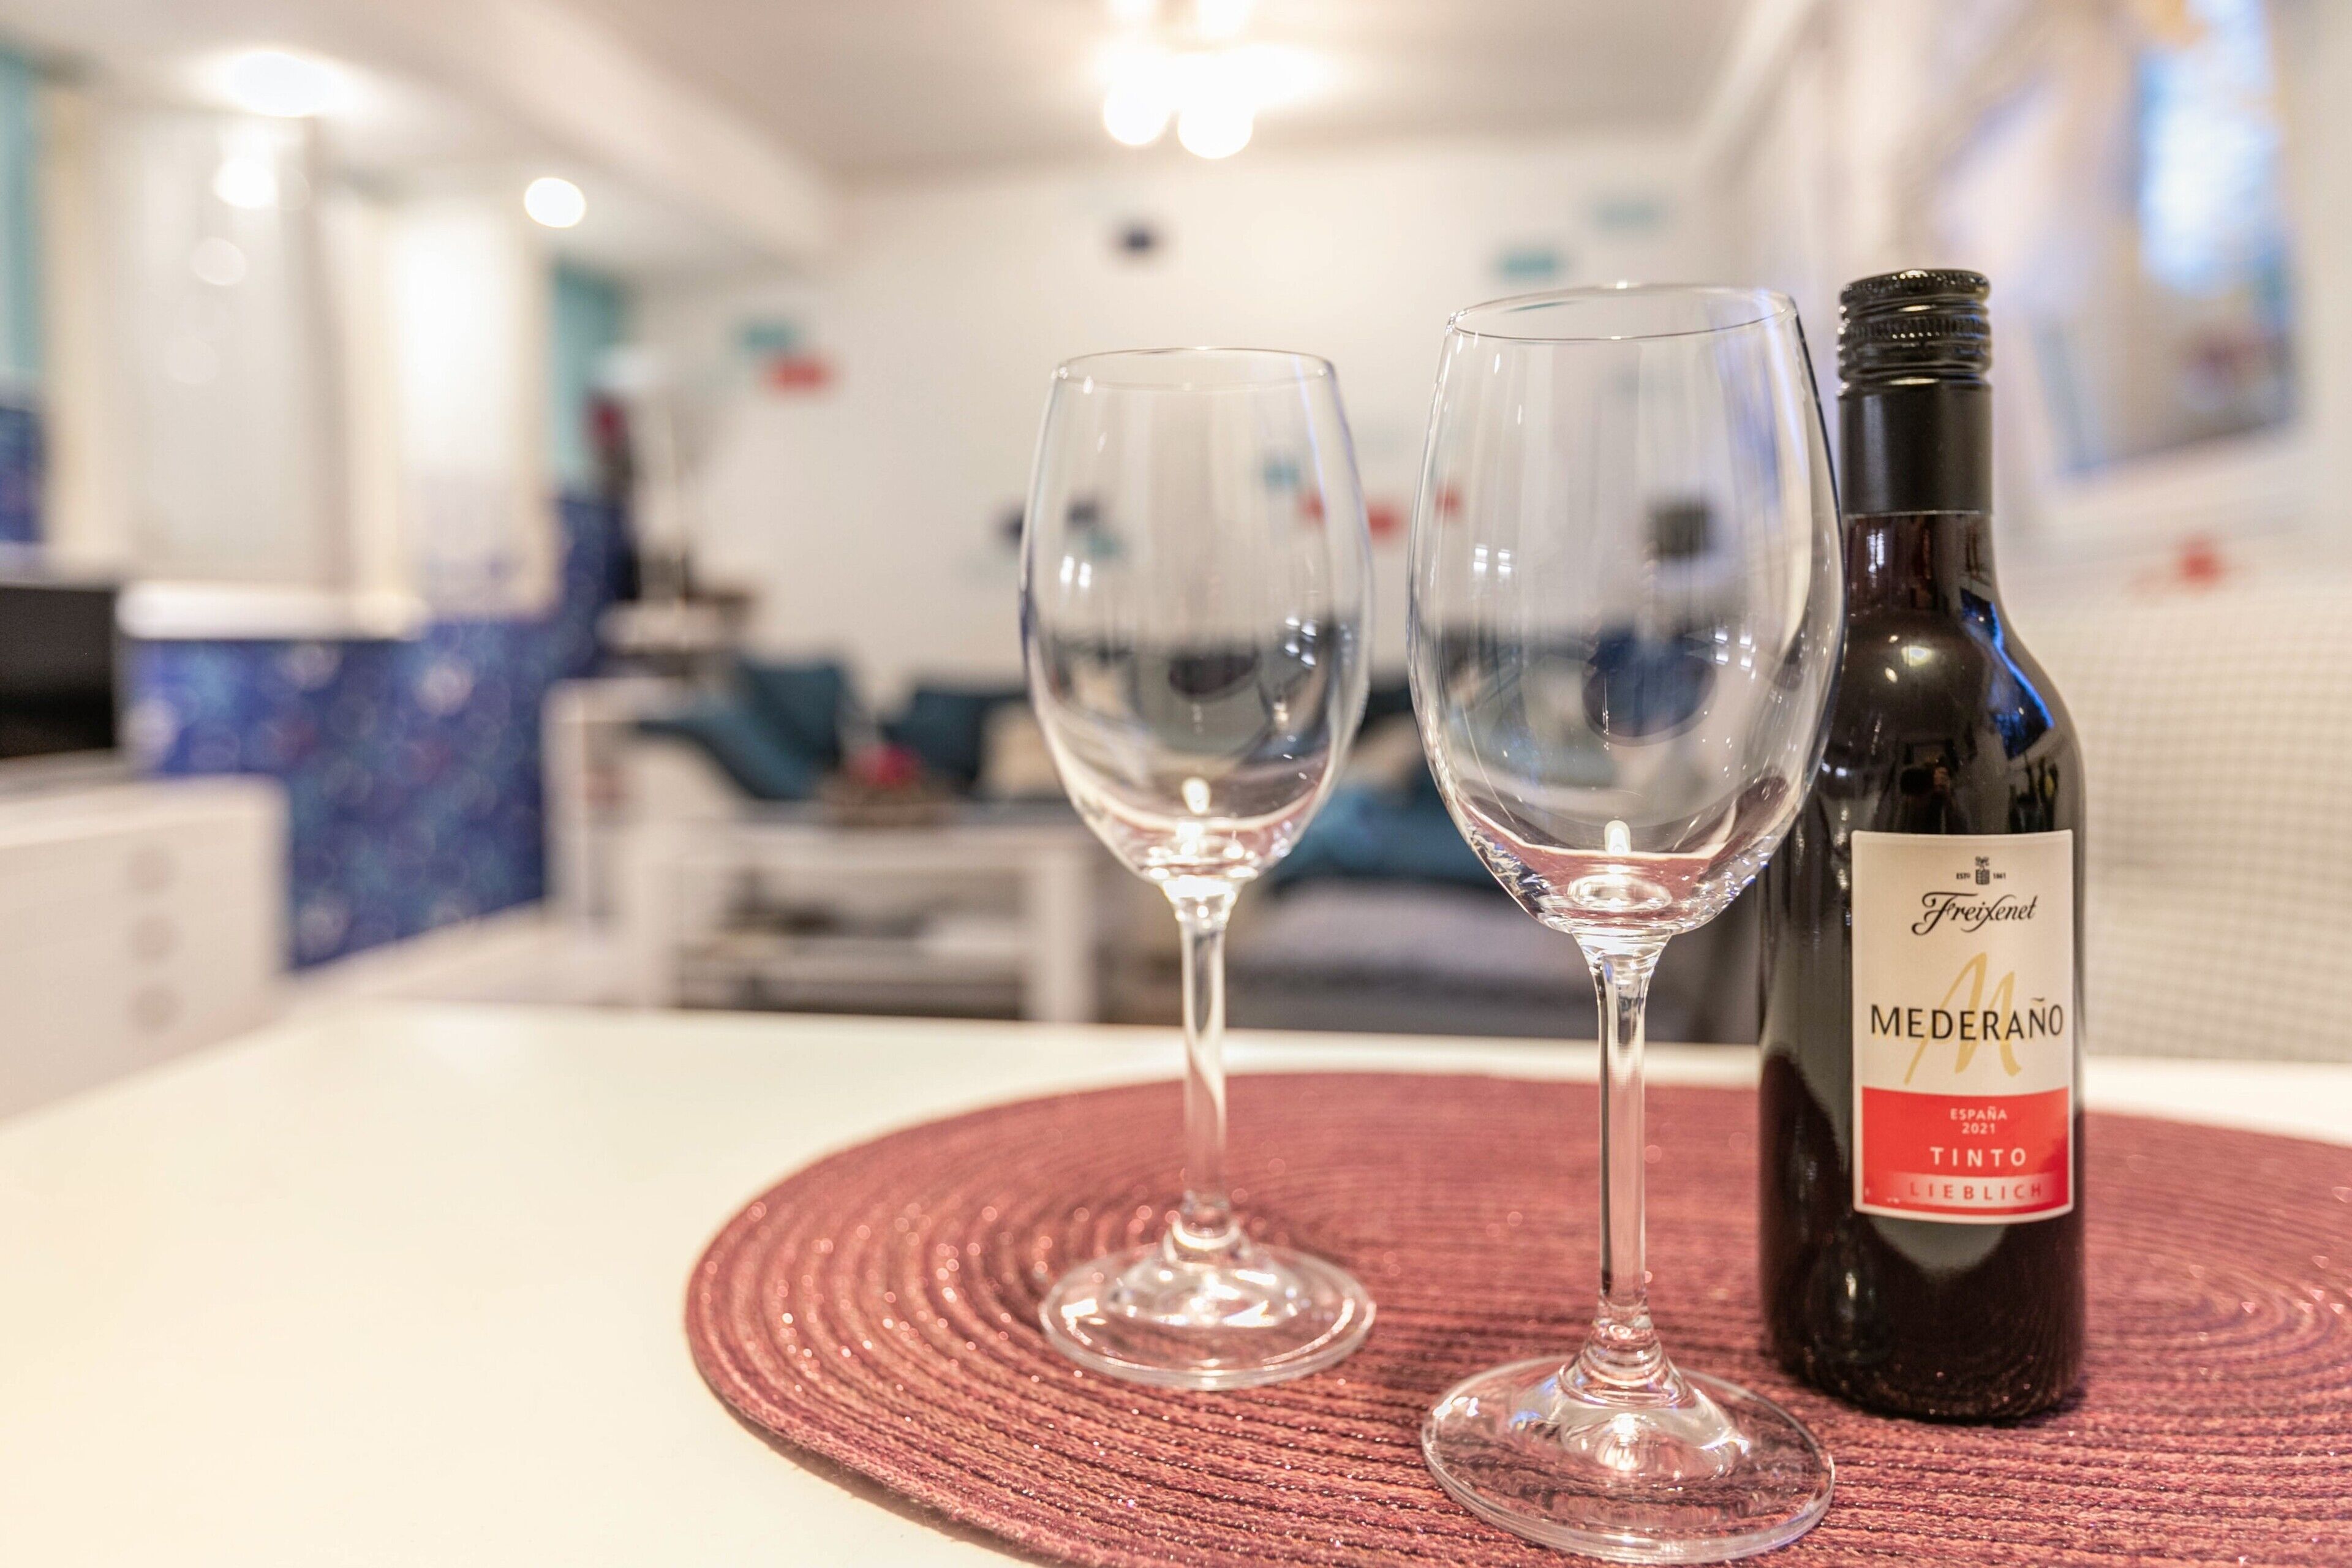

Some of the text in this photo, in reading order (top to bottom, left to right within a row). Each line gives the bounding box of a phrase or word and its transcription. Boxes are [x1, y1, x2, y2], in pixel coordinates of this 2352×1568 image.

[1911, 891, 2038, 936] Freixenet
[1871, 997, 2064, 1041] MEDERAÑO
[1950, 1106, 2008, 1120] ESPAÑA
[1961, 1123, 1996, 1134] 2021
[1929, 1147, 2026, 1167] TINTO
[1910, 1182, 2042, 1200] LIEBLICH
